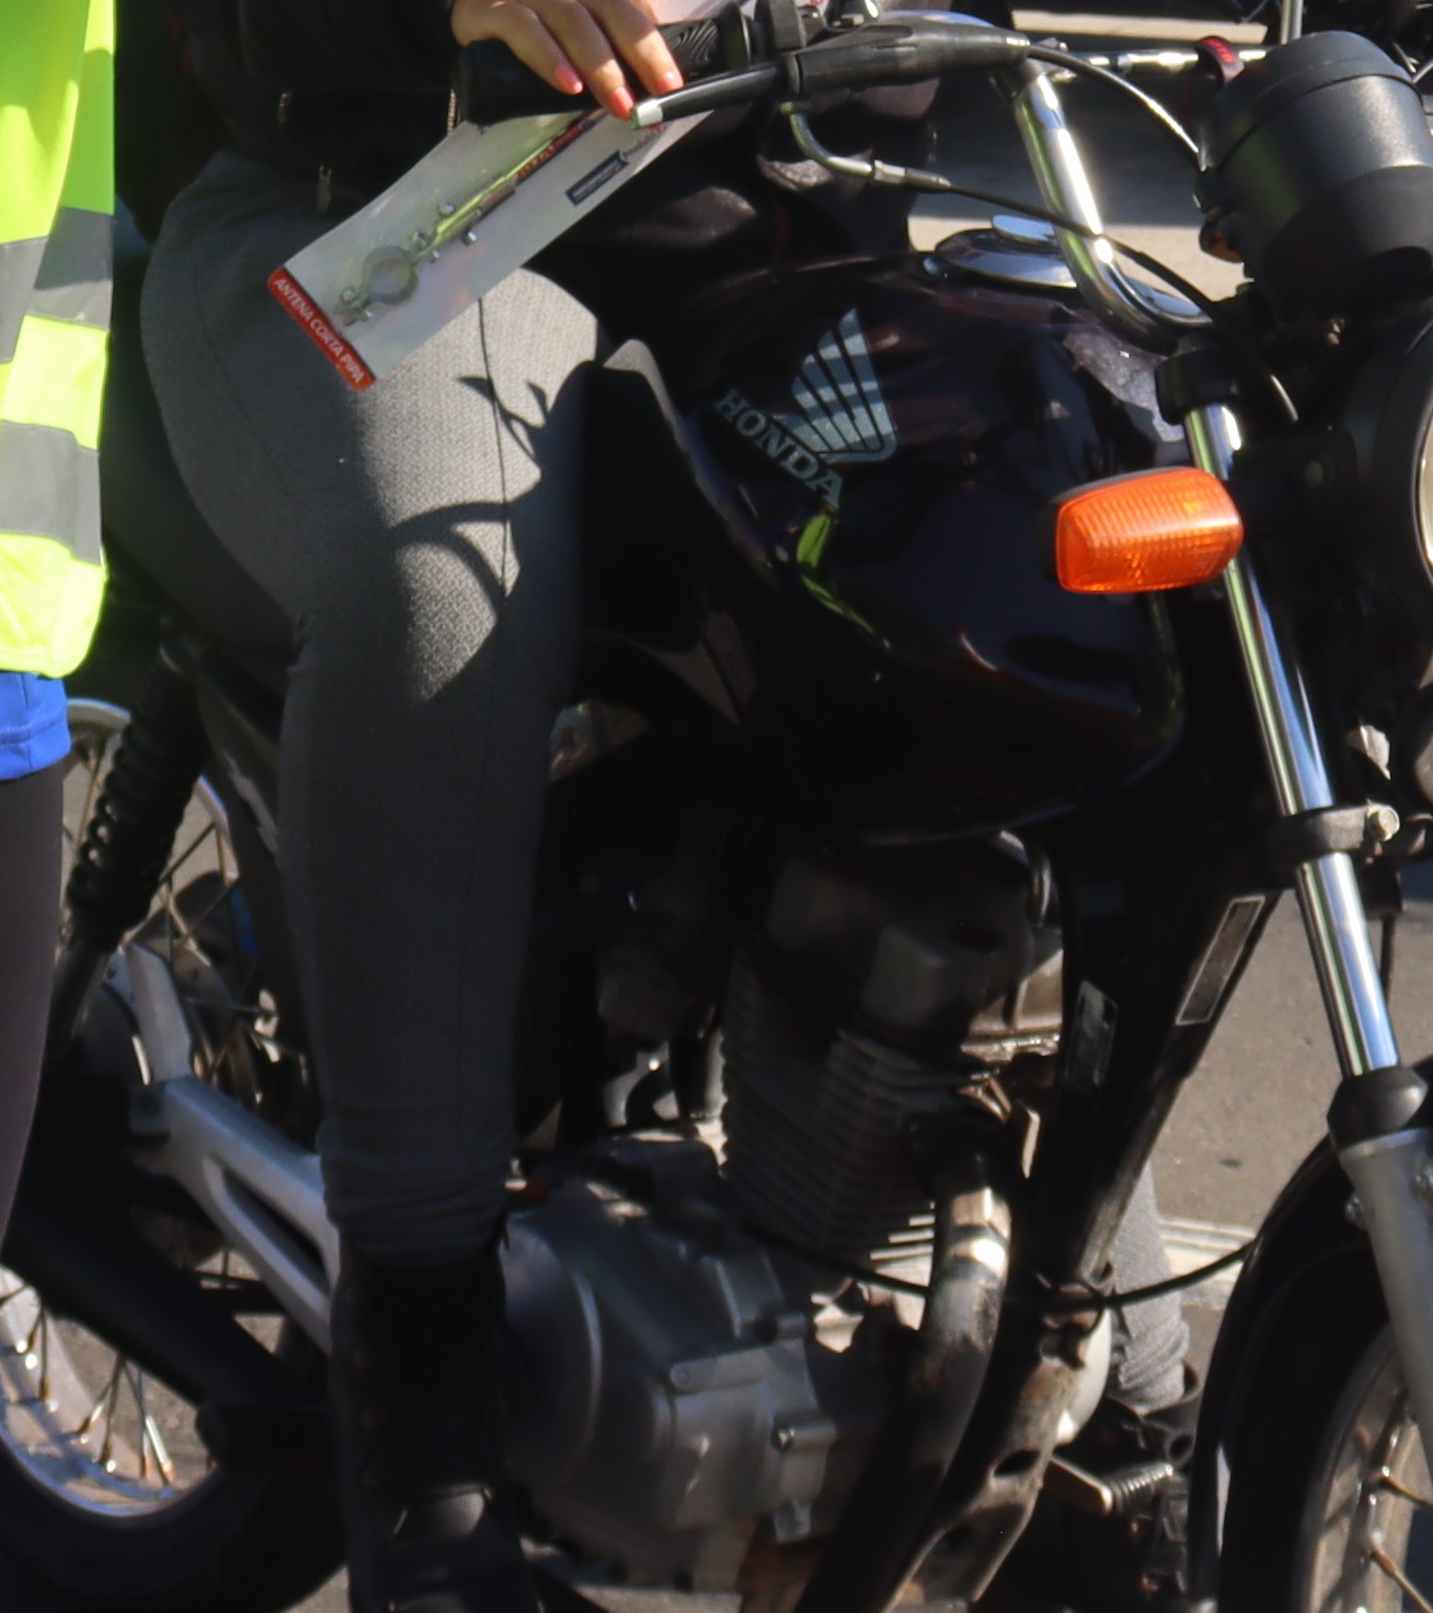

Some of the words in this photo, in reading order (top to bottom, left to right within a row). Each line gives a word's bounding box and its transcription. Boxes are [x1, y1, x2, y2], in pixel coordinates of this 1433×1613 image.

[273, 275, 315, 322] ANTENA
[308, 316, 345, 357] CORTA
[337, 352, 366, 383] PIPA
[714, 388, 843, 510] HONDA
